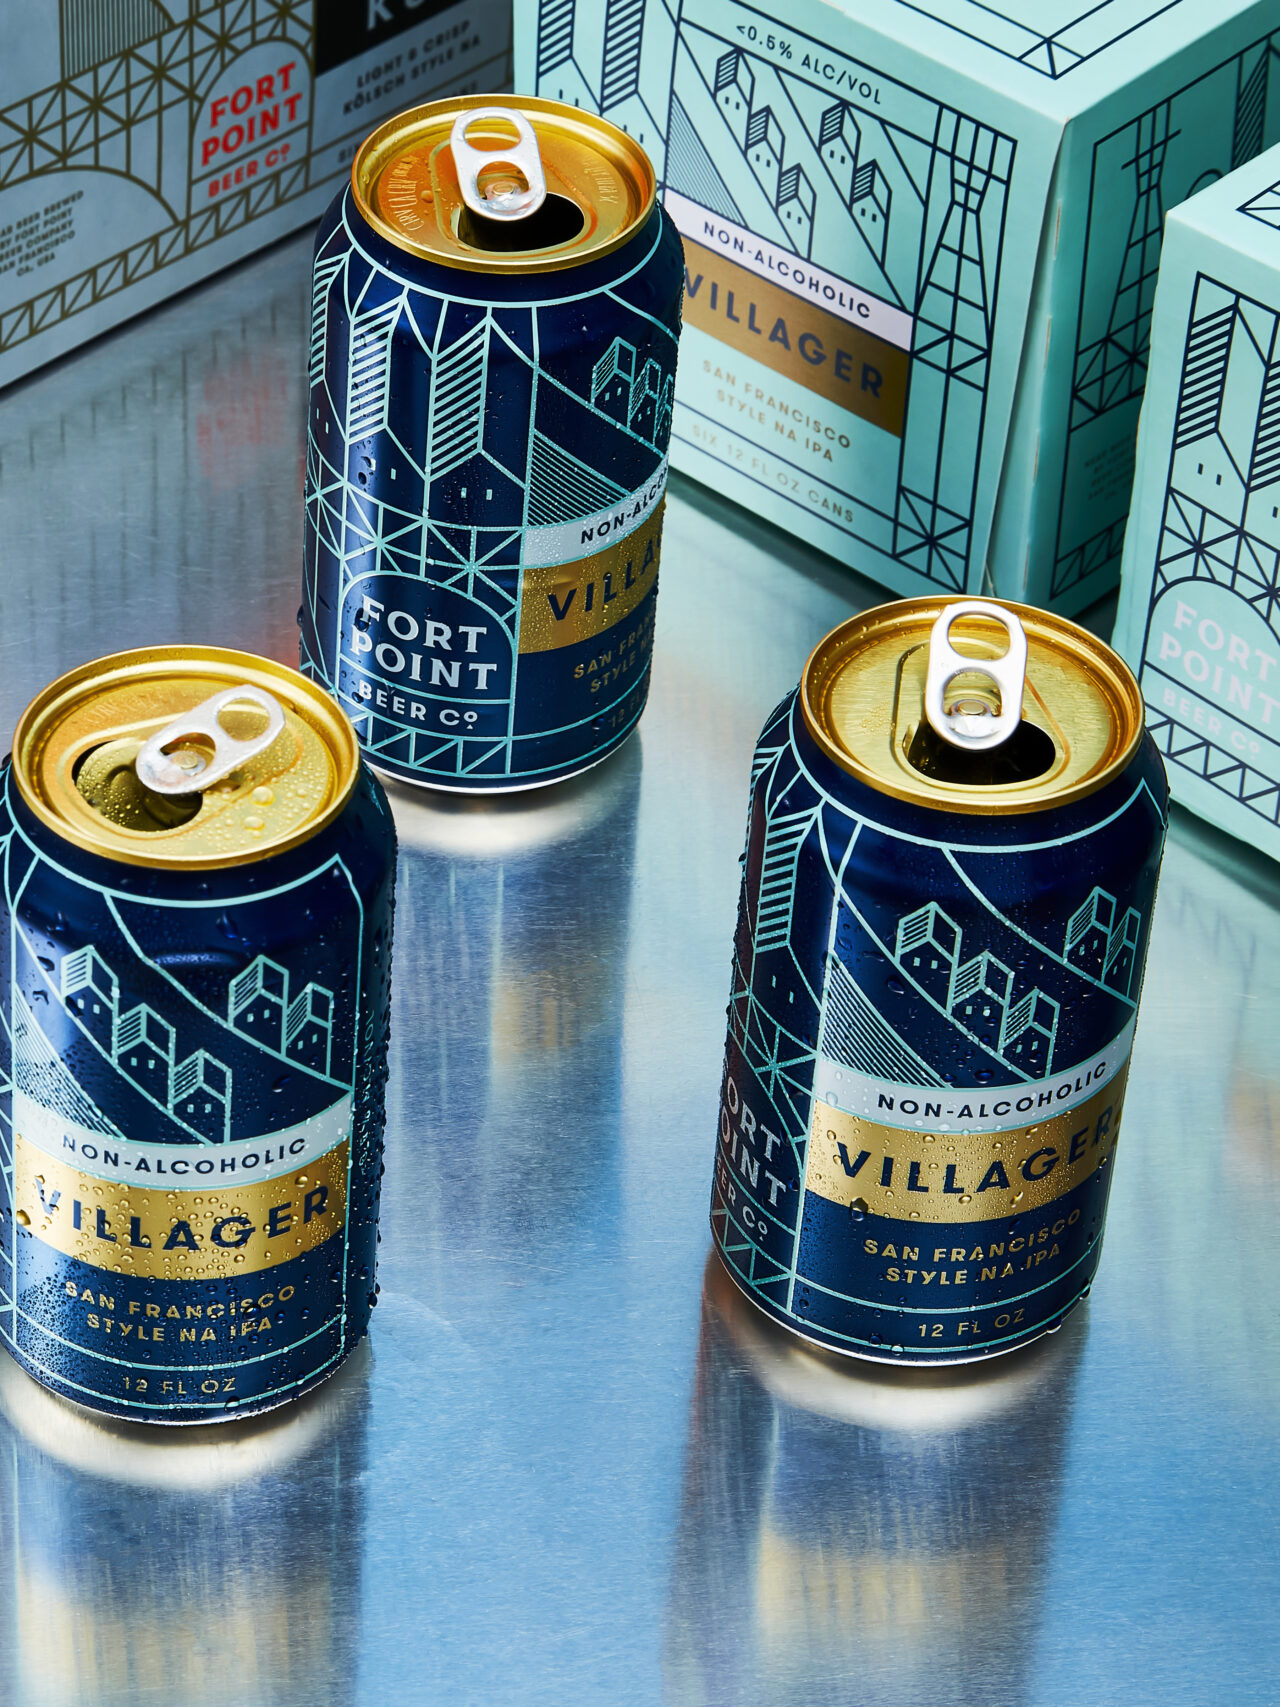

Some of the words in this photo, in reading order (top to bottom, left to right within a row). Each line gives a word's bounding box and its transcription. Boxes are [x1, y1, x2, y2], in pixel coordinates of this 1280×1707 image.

[357, 54, 402, 88] LIGHT
[423, 20, 470, 53] CRISP
[411, 49, 454, 80] STYLE
[460, 35, 480, 53] NA
[736, 25, 793, 59] <0.5%
[801, 53, 881, 104] ALC/VOL
[210, 61, 296, 129] FORT
[201, 92, 302, 166] POINT
[208, 160, 258, 198] BEER
[703, 221, 870, 319] NON-ALCOHOLIC
[684, 267, 883, 398] VILLAGER
[703, 359, 736, 386] SAN
[745, 382, 851, 449] FRANCISCO
[717, 389, 765, 424] STYLE
[774, 420, 797, 442] NA
[806, 438, 833, 462] IPA
[581, 466, 667, 544] NON-ALCO
[692, 424, 718, 447] SIX
[728, 444, 744, 462] 12
[752, 457, 768, 476] FL
[777, 472, 800, 493] OZ
[808, 489, 853, 523] CANS
[547, 537, 660, 621] VILLA
[361, 593, 487, 653] FORT
[1173, 600, 1277, 682] FORT
[349, 624, 497, 690] POINT
[573, 650, 611, 679] SAN
[590, 651, 636, 693] STYLE
[1159, 632, 1280, 725] POINT
[358, 679, 427, 720] BEER
[1162, 688, 1222, 736] BEER
[877, 1061, 1106, 1119] NON-ALCOHOLIC
[62, 1135, 306, 1175] NON-ALCOHOLIC
[721, 1105, 786, 1207] OINT
[837, 1105, 1113, 1194] VILLAGER
[34, 1178, 329, 1251] VILLAGER
[863, 1239, 919, 1261] SAN
[933, 1209, 1080, 1262] FRANCISCO
[886, 1267, 967, 1285] STYLE
[981, 1262, 1014, 1282] NA
[1026, 1243, 1060, 1270] IPA
[65, 1281, 115, 1311] SAN
[129, 1285, 295, 1320] FRANCISCO
[87, 1312, 165, 1341] STYLE
[179, 1329, 216, 1342] NA
[230, 1316, 272, 1337] IPA
[918, 1324, 943, 1337] 12
[958, 1321, 981, 1336] FL
[994, 1308, 1025, 1328] OZ
[122, 1376, 148, 1393] 12
[162, 1381, 187, 1395] FL
[201, 1377, 236, 1394] OZ
